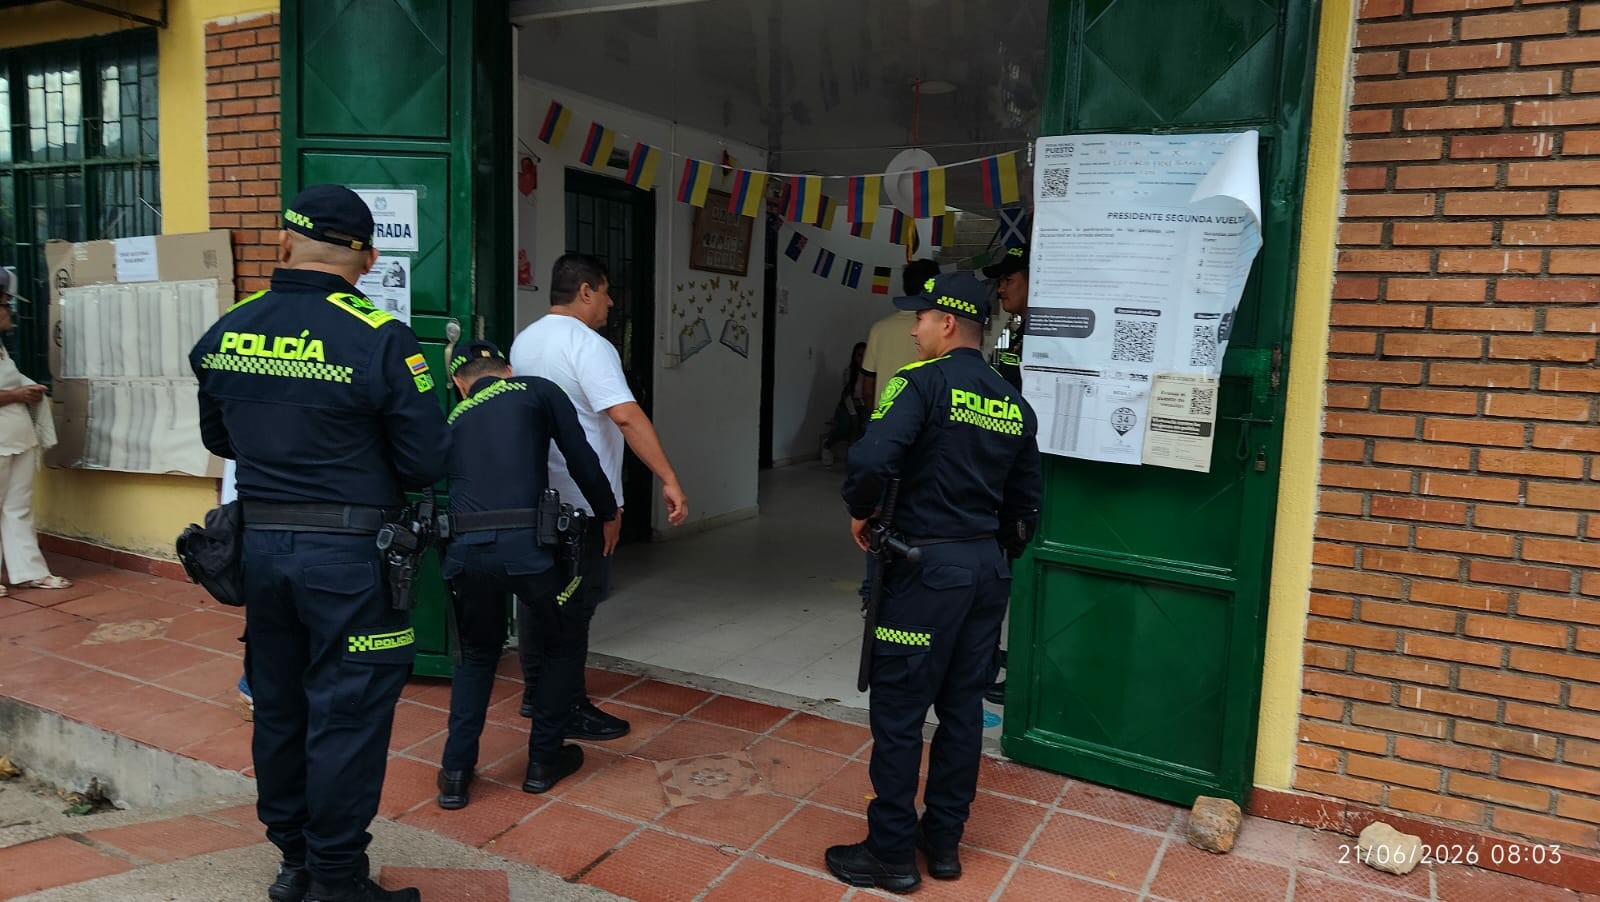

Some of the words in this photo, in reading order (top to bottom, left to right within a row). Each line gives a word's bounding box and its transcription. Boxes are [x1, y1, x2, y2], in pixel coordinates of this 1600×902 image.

[1045, 146, 1075, 154] PUESTO
[1107, 212, 1163, 222] PRESIDENTE
[1165, 214, 1213, 224] SEGUNDA
[375, 223, 412, 238] RADA
[220, 329, 325, 362] POLICÍA
[952, 388, 1023, 422] POLICÍA
[1117, 415, 1129, 423] 34
